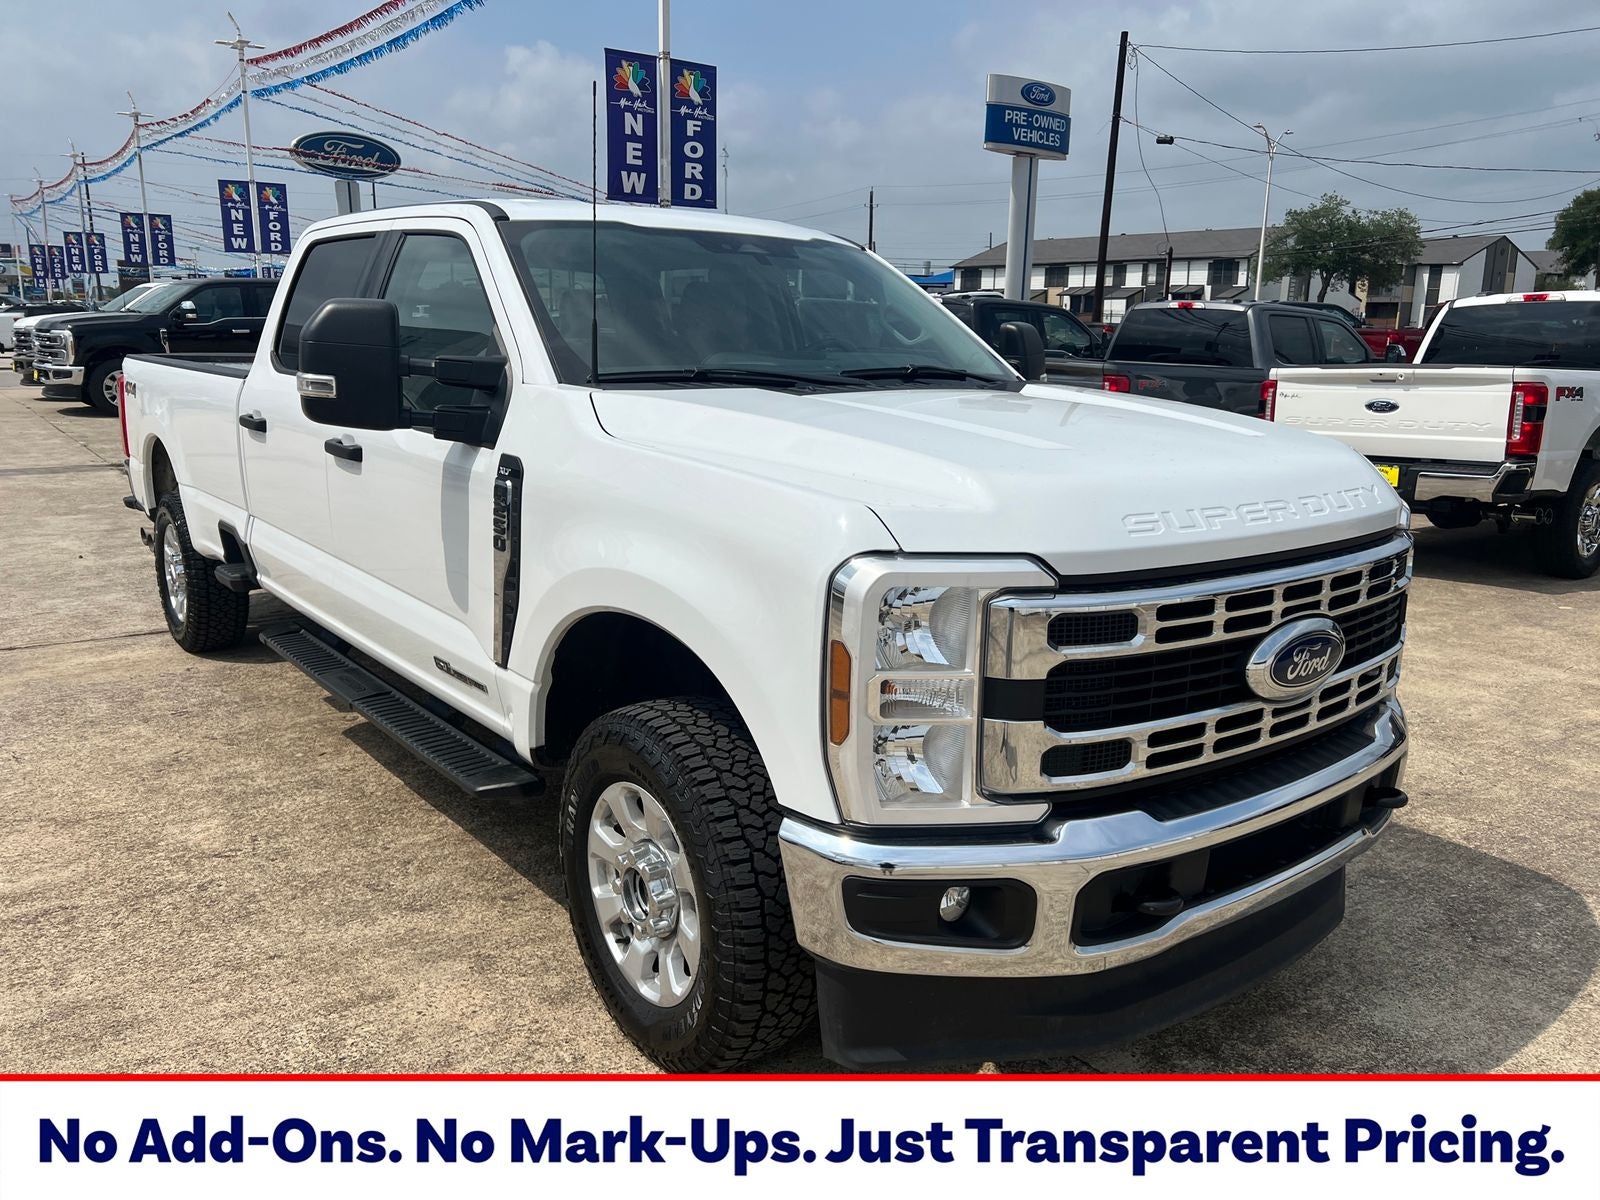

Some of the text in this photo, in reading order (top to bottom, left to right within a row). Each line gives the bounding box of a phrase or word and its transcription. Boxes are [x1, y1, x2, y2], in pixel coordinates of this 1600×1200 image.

[1030, 86, 1051, 102] Ford
[1004, 109, 1067, 132] PRE-OWNED
[1012, 127, 1061, 147] VEHICLES
[620, 112, 647, 195] NEW
[683, 119, 704, 200] FORD
[230, 209, 248, 249] NEW
[268, 211, 282, 251] FORD
[70, 248, 82, 271] NEW
[93, 248, 103, 272] FORD
[129, 233, 142, 263] NEW
[157, 234, 169, 264] FORD
[1555, 386, 1584, 401] FX4
[1284, 415, 1492, 432] SUPER DUTY
[1121, 484, 1383, 538] SUPER DUTY
[1286, 642, 1332, 680] Ford
